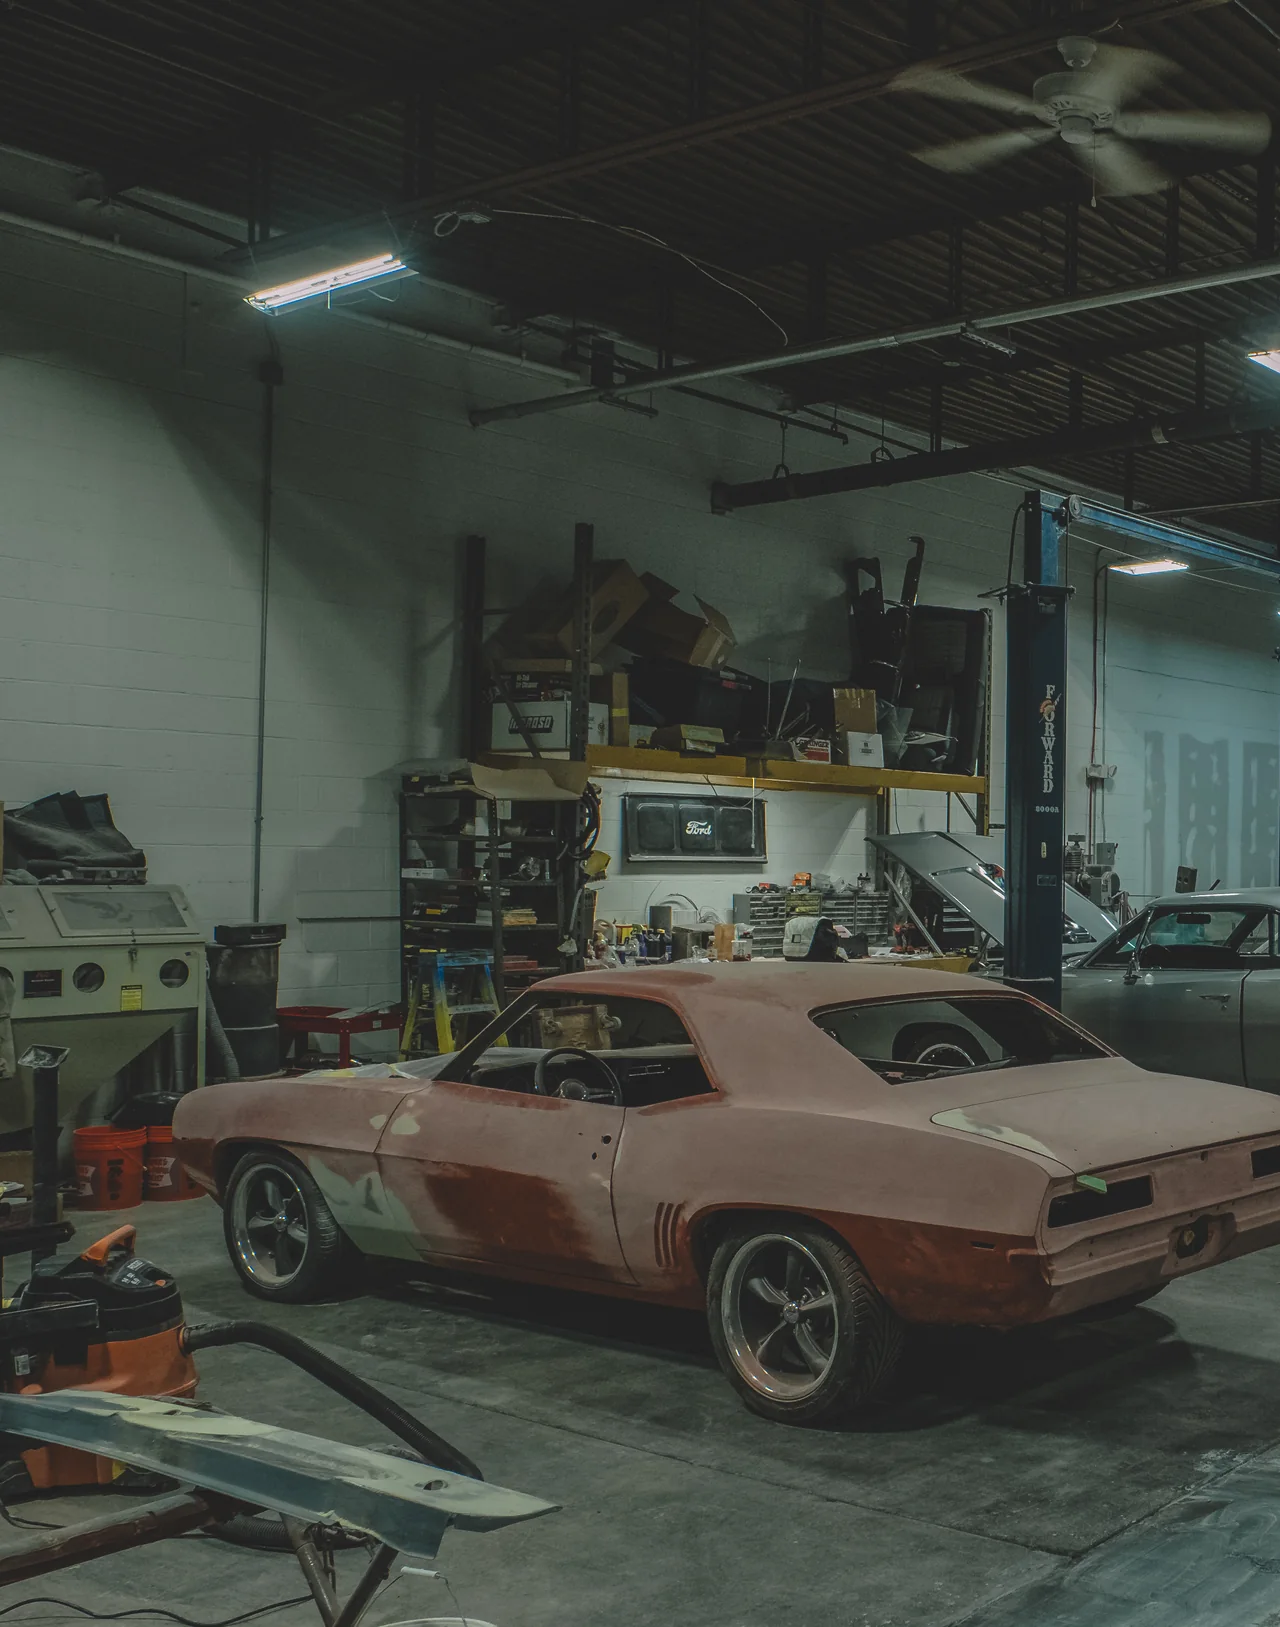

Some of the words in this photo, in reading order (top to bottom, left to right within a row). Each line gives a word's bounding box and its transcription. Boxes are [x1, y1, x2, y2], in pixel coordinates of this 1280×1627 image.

[509, 716, 552, 730] MROSO
[1041, 684, 1056, 793] FORWARD
[685, 820, 712, 835] Ford
